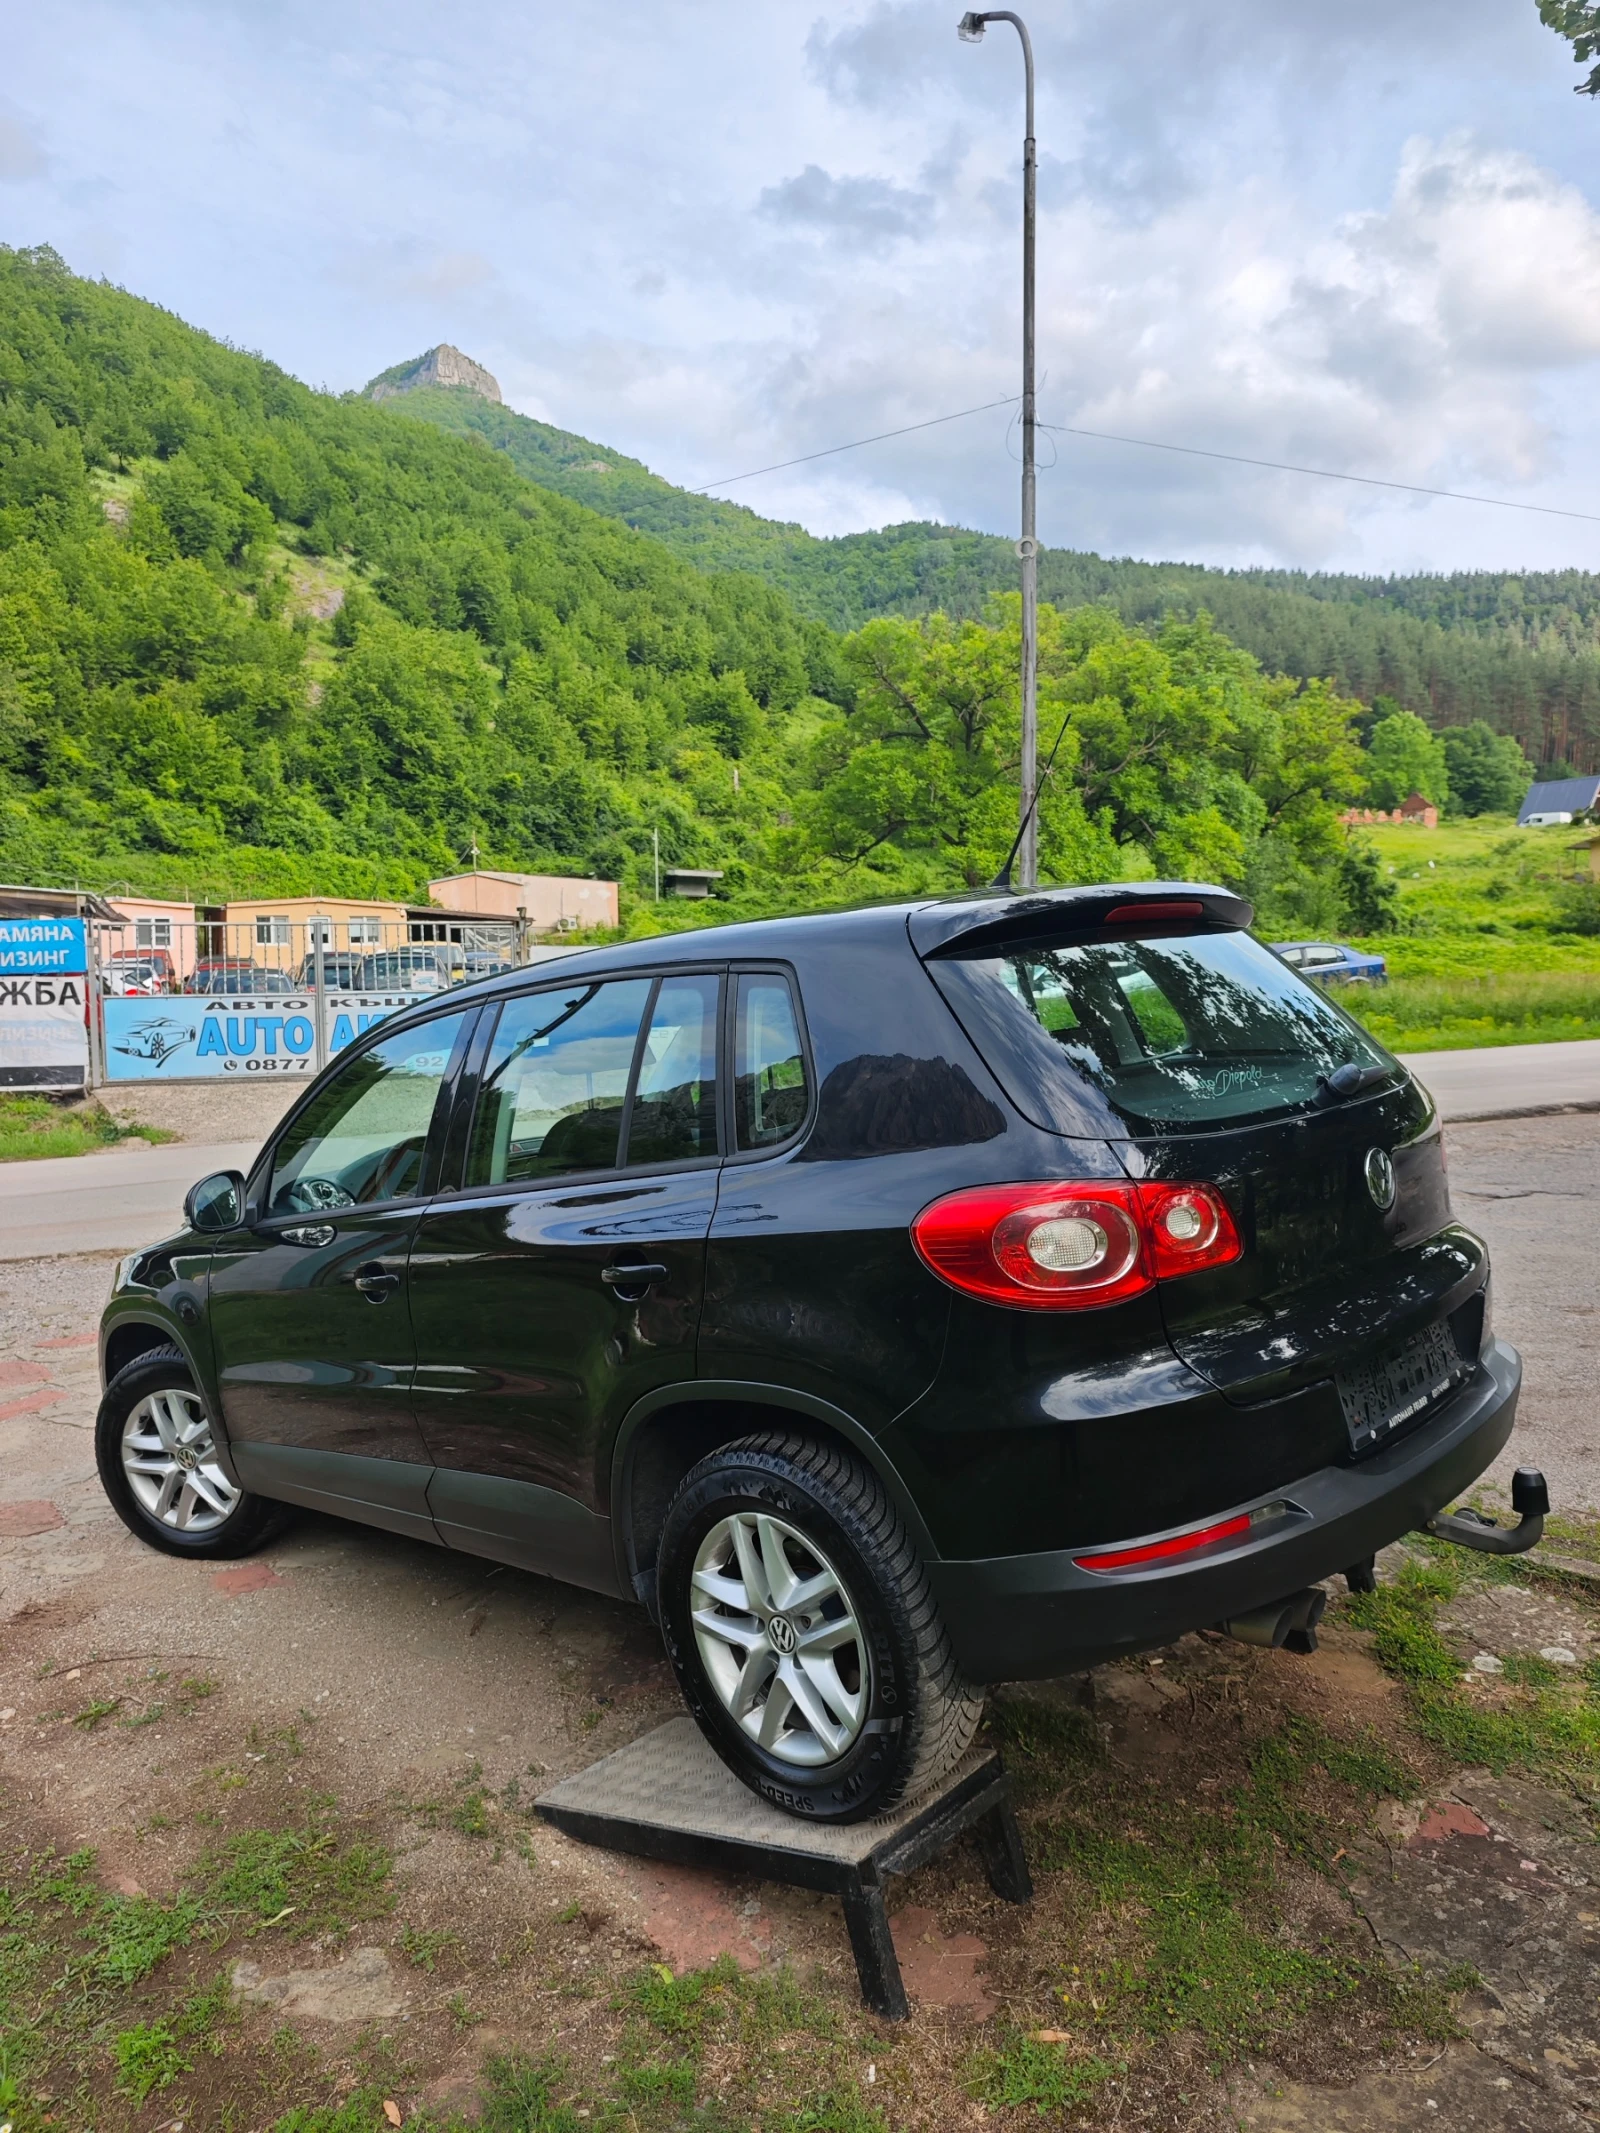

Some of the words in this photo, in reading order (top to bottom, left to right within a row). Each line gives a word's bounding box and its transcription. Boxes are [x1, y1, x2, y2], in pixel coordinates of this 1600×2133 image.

[0, 981, 81, 1006] ЖБА
[205, 999, 309, 1011] АВТО
[196, 1016, 315, 1057] AUTO
[245, 1058, 310, 1071] 0877
